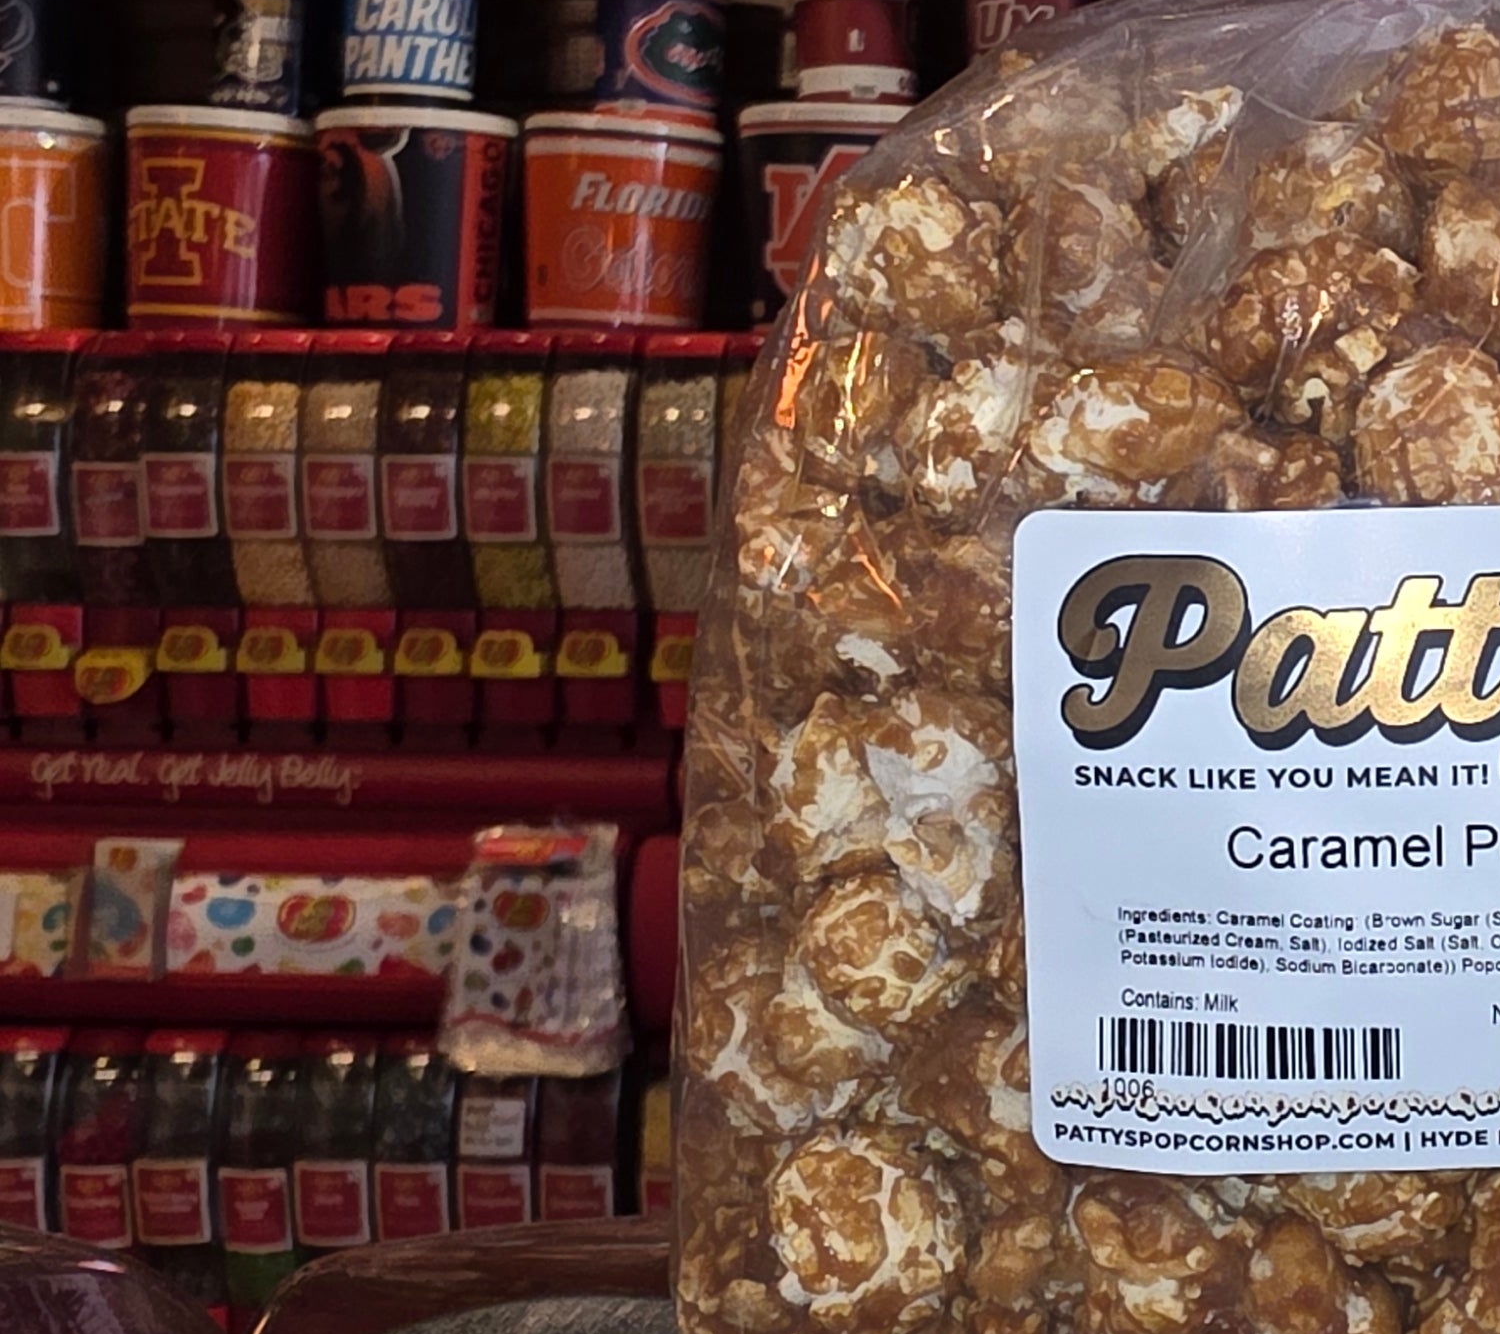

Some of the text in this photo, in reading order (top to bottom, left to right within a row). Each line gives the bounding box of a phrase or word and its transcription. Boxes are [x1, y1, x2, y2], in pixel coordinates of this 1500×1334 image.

[1074, 765, 1489, 790] SNACK LIKE YOU MEAN IT!
[1227, 824, 1444, 869] Caramel
[1117, 907, 1212, 925] Ingredients:
[1216, 910, 1285, 928] Caramel
[1364, 914, 1425, 931] (Brown
[1430, 911, 1480, 931] Sugar
[1118, 928, 1221, 948] (Pasteurized
[1224, 933, 1285, 952] Cream,
[1337, 935, 1398, 952] Iodized
[1403, 935, 1436, 951] Salt
[1120, 948, 1205, 968] Potassium
[1275, 957, 1337, 975] Sodium
[1120, 987, 1240, 1013] Contains: Milk
[1100, 1077, 1156, 1101] 1006
[1053, 1122, 1397, 1153] PATTYSPOPCORNSHOP.COM
[1420, 1129, 1489, 1148] HYDE
